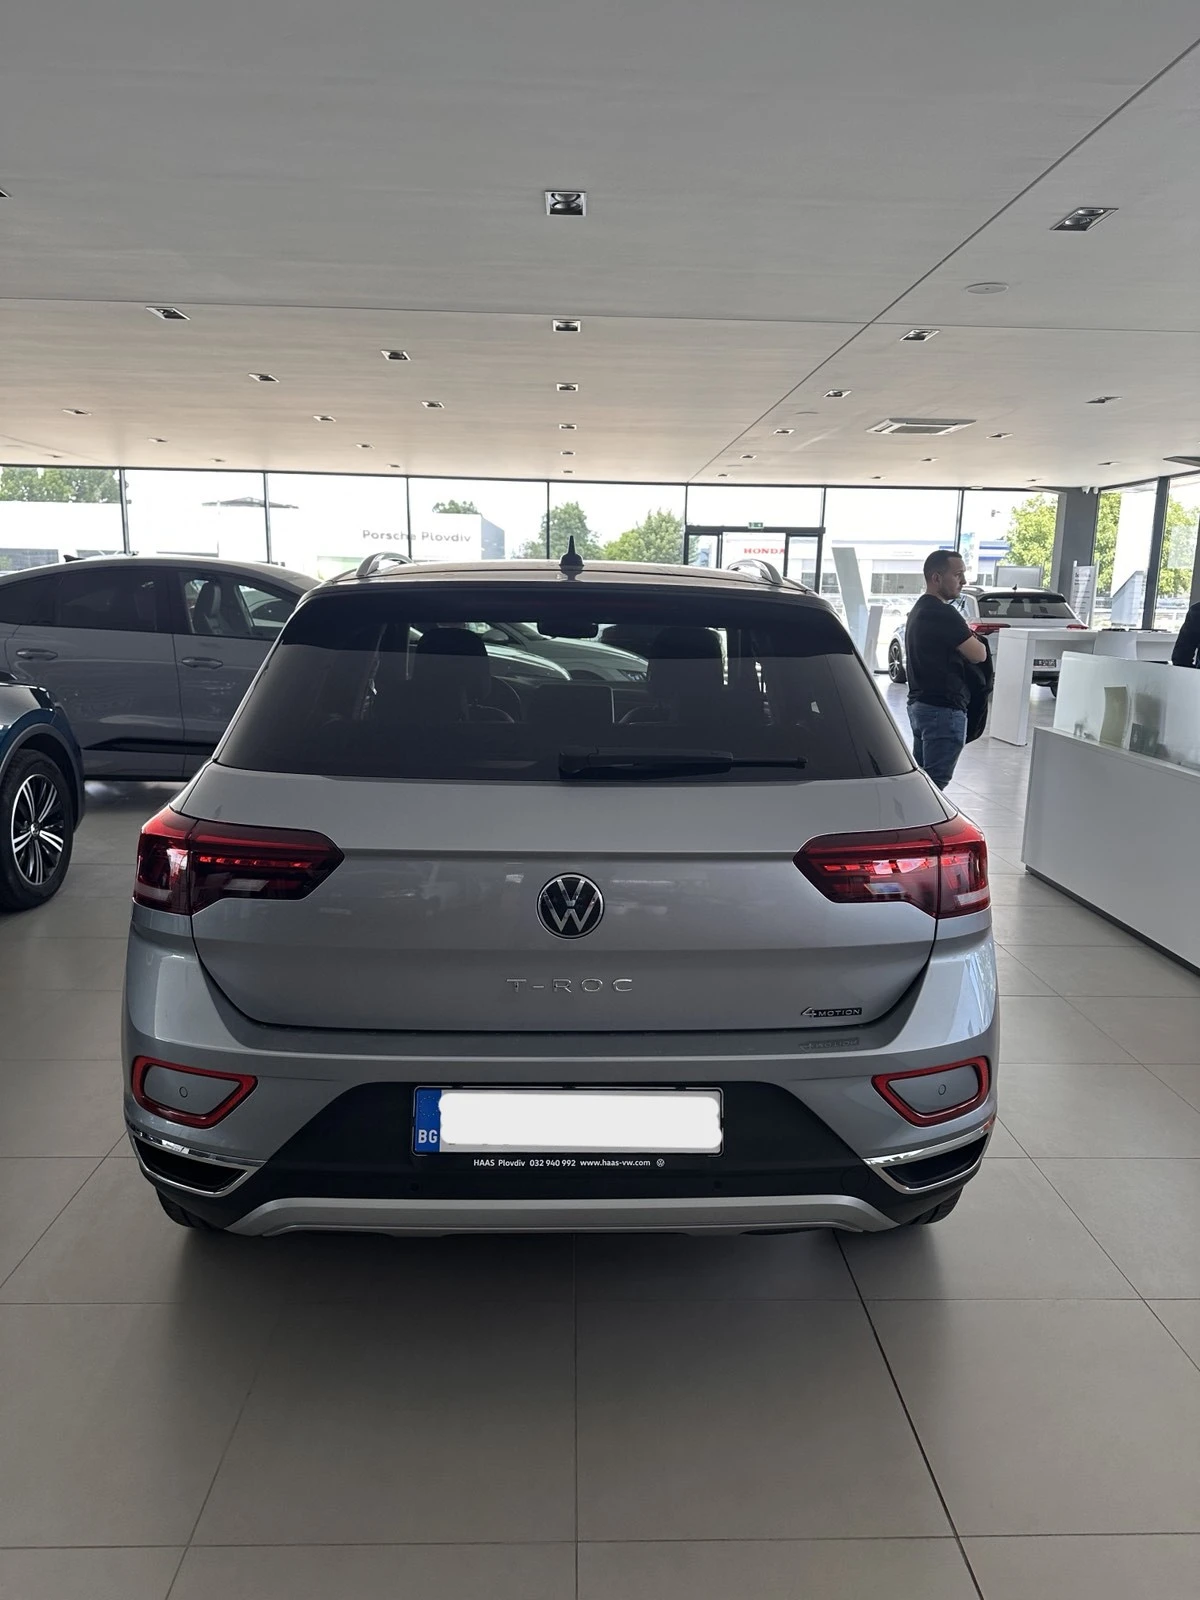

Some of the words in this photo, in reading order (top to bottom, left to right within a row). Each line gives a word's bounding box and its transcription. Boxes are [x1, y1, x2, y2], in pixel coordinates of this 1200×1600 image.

[362, 529, 417, 541] Porsche
[421, 531, 471, 542] Plovdiv
[506, 978, 633, 993] T-ROC
[801, 1007, 861, 1018] 4MOTION
[418, 1129, 438, 1144] BG
[473, 1159, 495, 1167] HAAS
[498, 1159, 526, 1167] Plovdiv
[529, 1159, 544, 1167] 032
[545, 1159, 561, 1167] 940
[561, 1159, 576, 1167] 992
[580, 1158, 651, 1167] www.haas-vw.com
